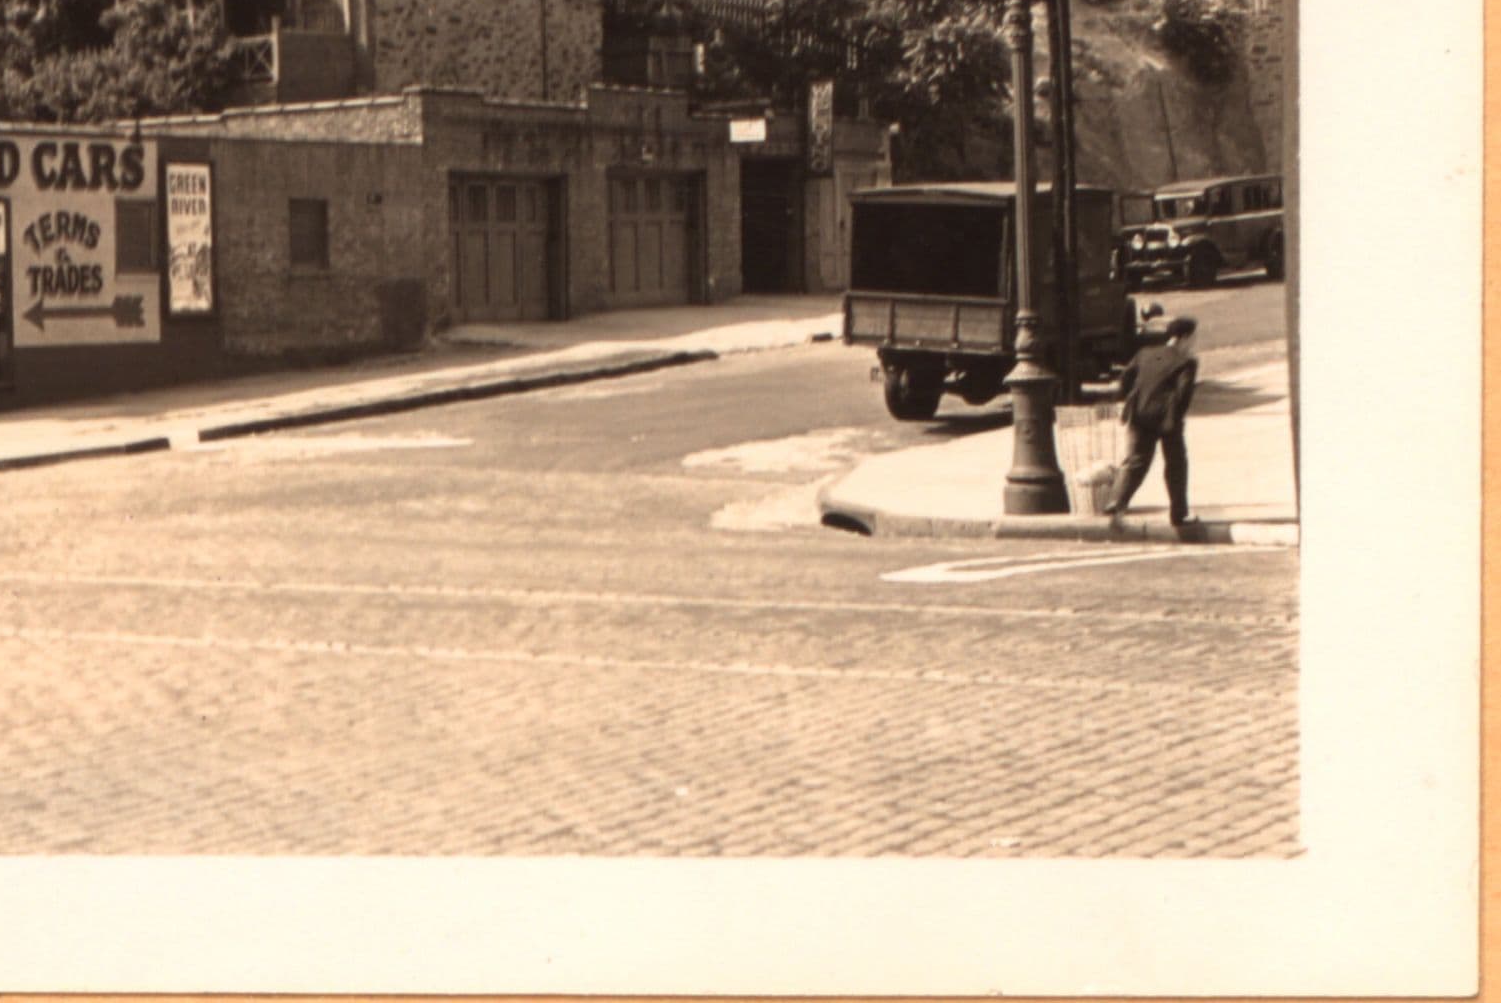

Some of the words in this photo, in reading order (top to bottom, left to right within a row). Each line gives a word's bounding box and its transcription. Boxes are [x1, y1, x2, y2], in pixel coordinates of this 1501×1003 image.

[32, 143, 145, 191] CARS
[169, 175, 207, 195] GREEN
[171, 198, 207, 215] RIVER
[23, 211, 102, 255] TERMS
[26, 265, 104, 294] TRADES
